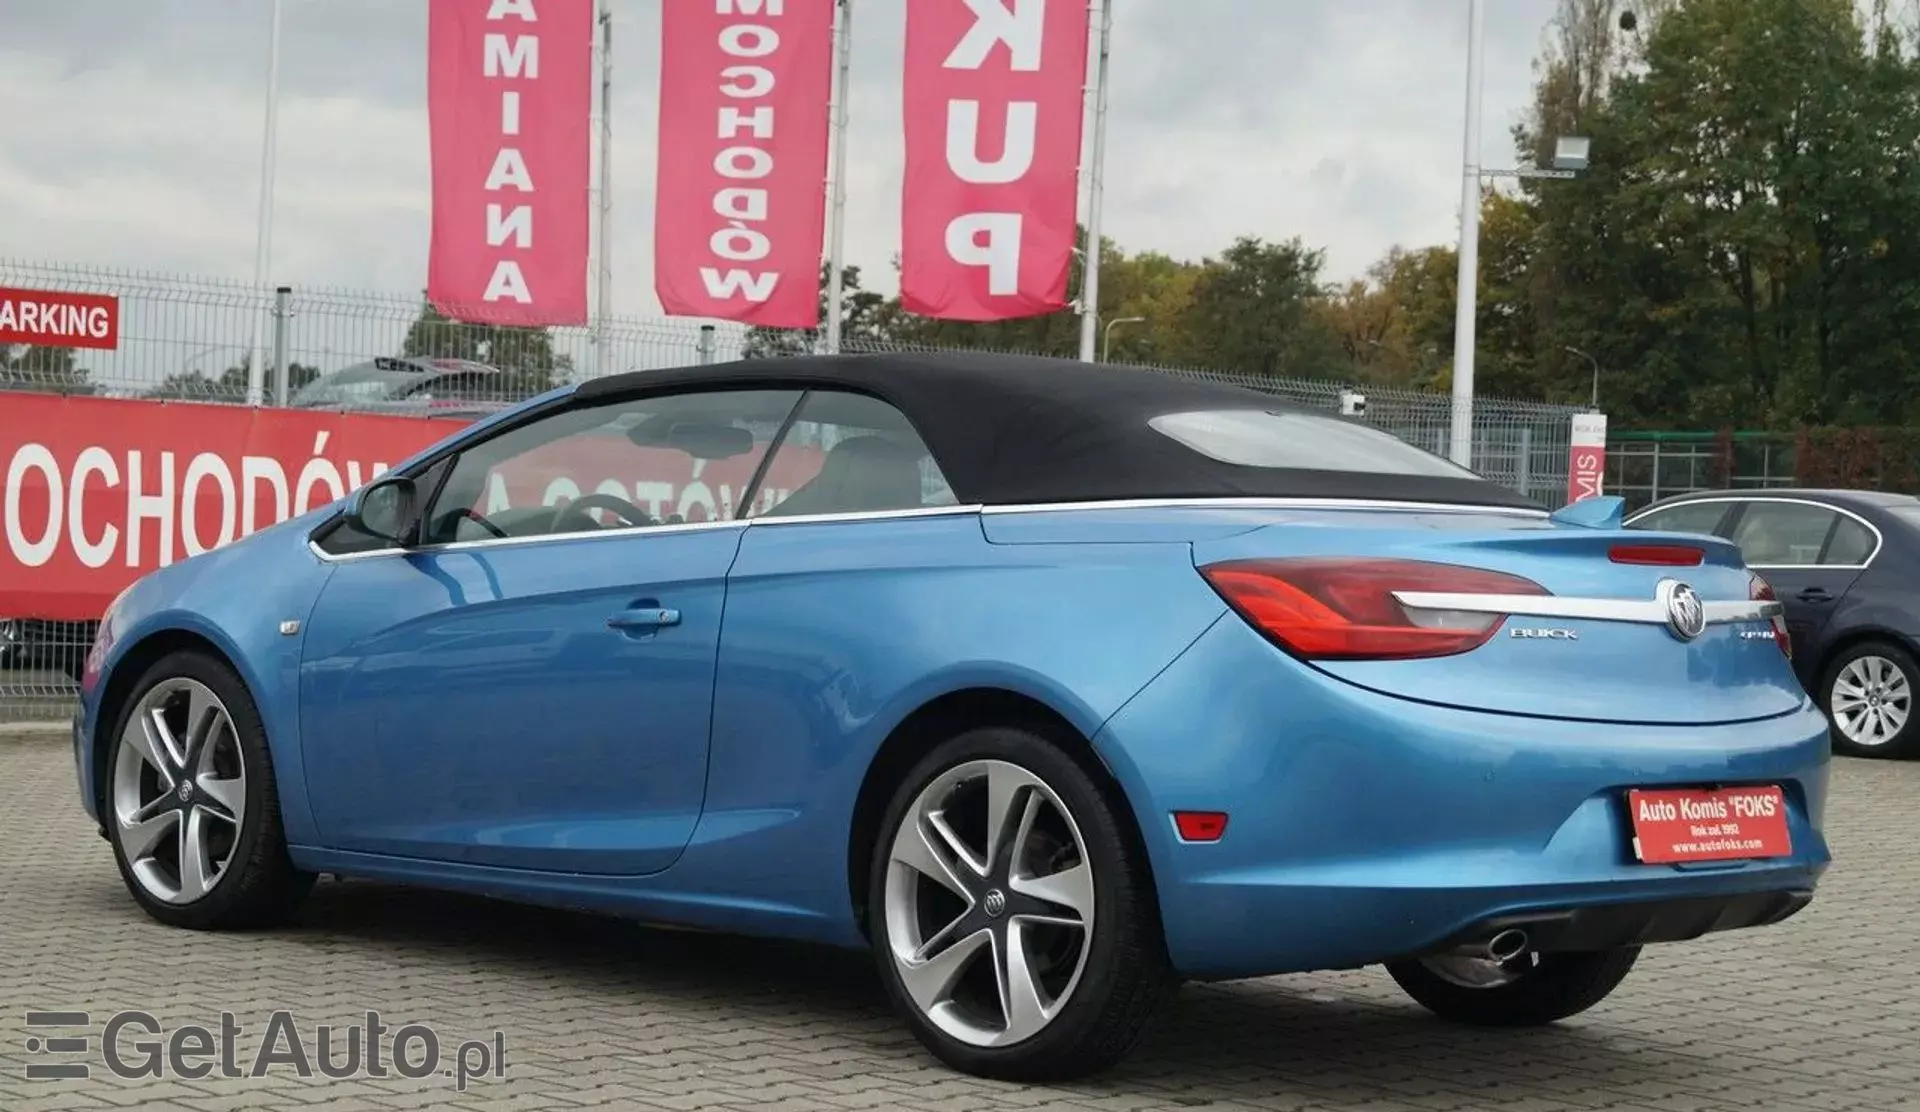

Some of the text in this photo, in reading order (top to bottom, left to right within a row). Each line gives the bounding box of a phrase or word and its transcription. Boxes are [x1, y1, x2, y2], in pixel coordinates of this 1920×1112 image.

[0, 299, 109, 338] ARKING
[4, 430, 388, 568] OCHODÓ
[1510, 627, 1578, 641] BUICK
[1639, 799, 1676, 822] Auto
[1680, 797, 1727, 820] Komis
[1672, 837, 1763, 853] www.autofoks.com
